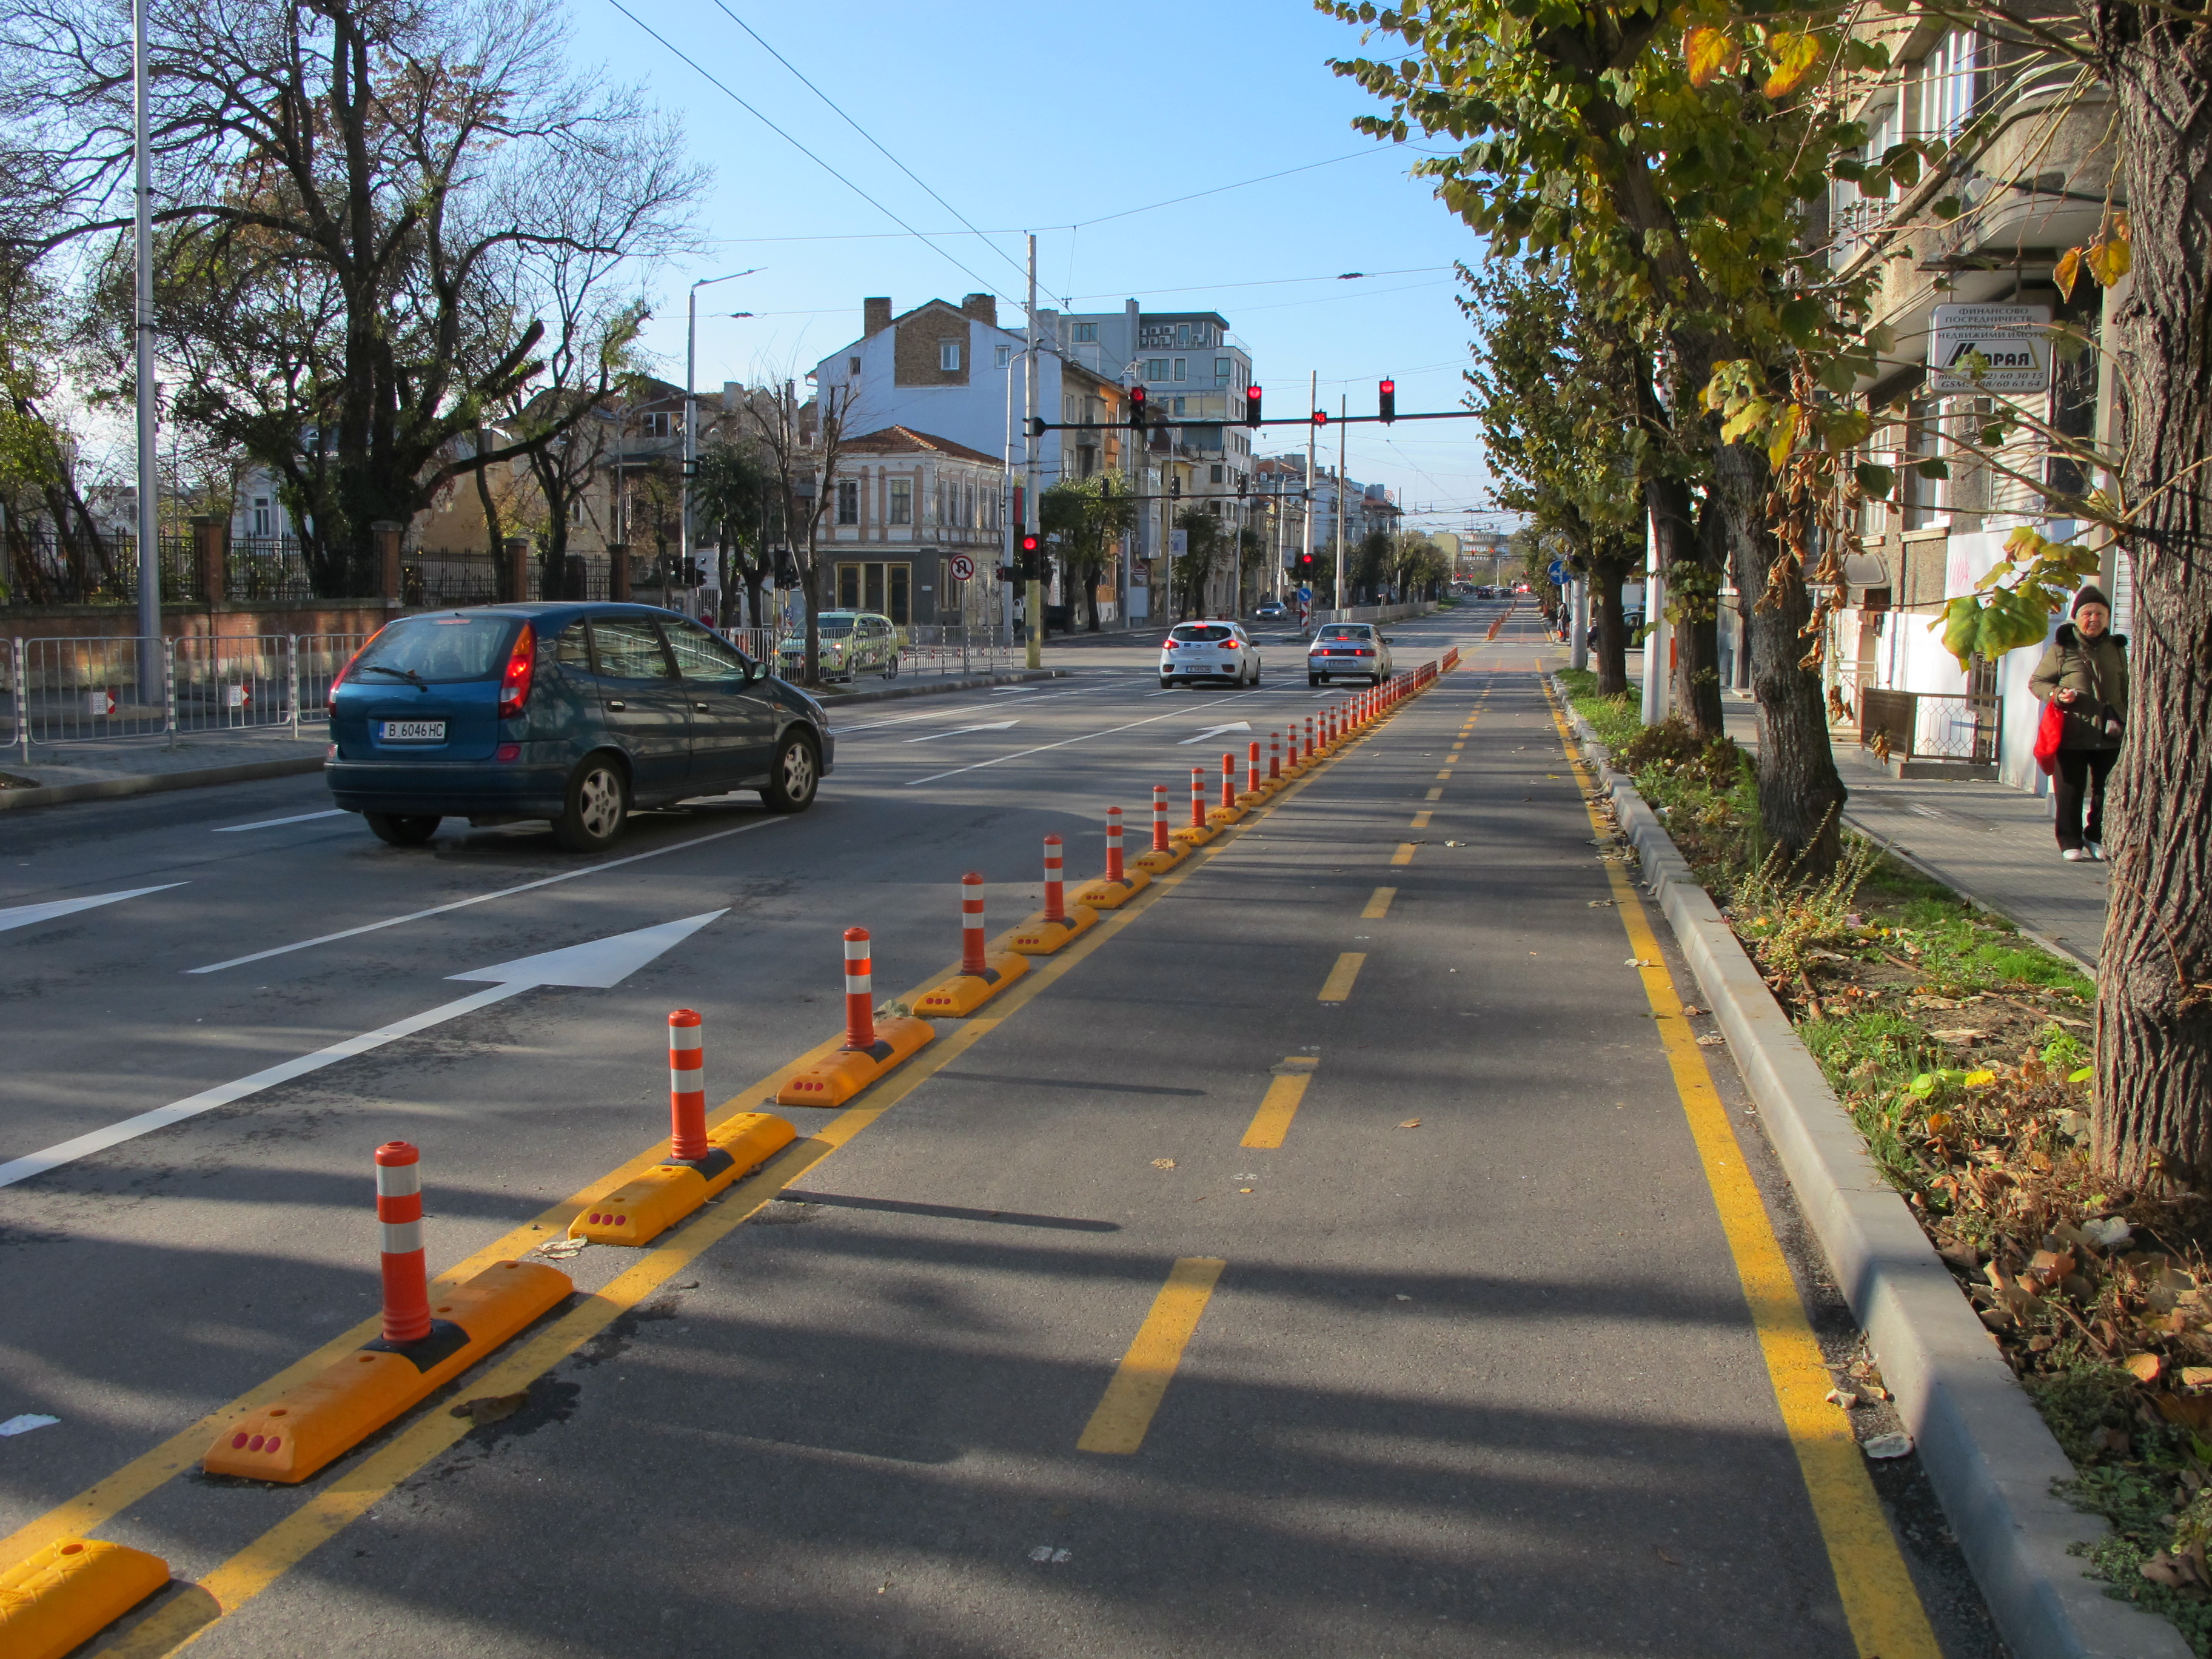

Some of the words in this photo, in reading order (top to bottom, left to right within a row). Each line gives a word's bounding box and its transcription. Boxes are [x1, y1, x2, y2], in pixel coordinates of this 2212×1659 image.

[389, 724, 396, 737] B
[401, 723, 427, 737] 6046
[429, 723, 443, 737] HC
